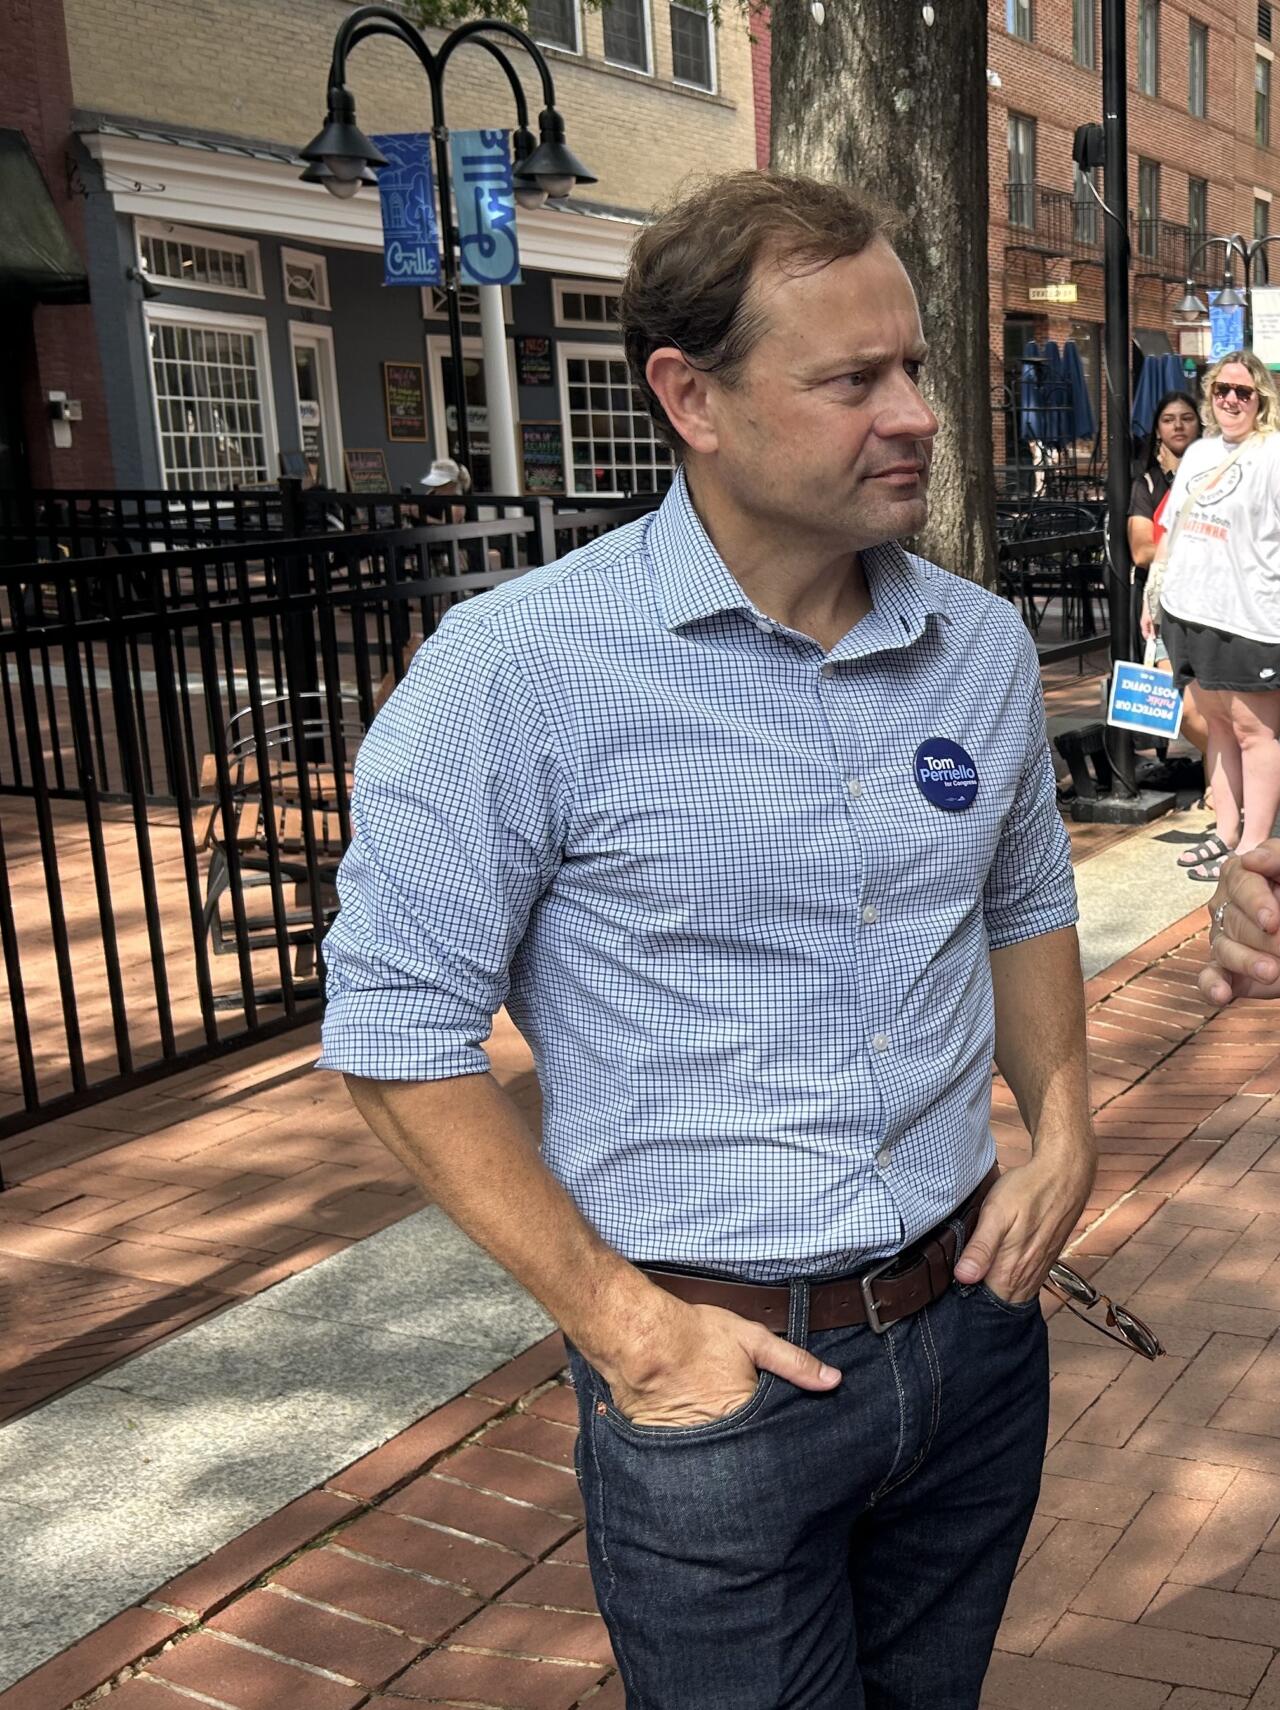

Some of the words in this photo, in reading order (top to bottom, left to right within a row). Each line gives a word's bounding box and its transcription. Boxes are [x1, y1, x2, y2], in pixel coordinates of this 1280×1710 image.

[387, 241, 437, 275] Cville
[1121, 680, 1152, 693] OFFICE
[1151, 685, 1178, 700] POST
[1115, 700, 1131, 711] OUR
[1131, 703, 1173, 720] PROTECT
[923, 756, 955, 771] Tom
[920, 765, 976, 782] Perriello
